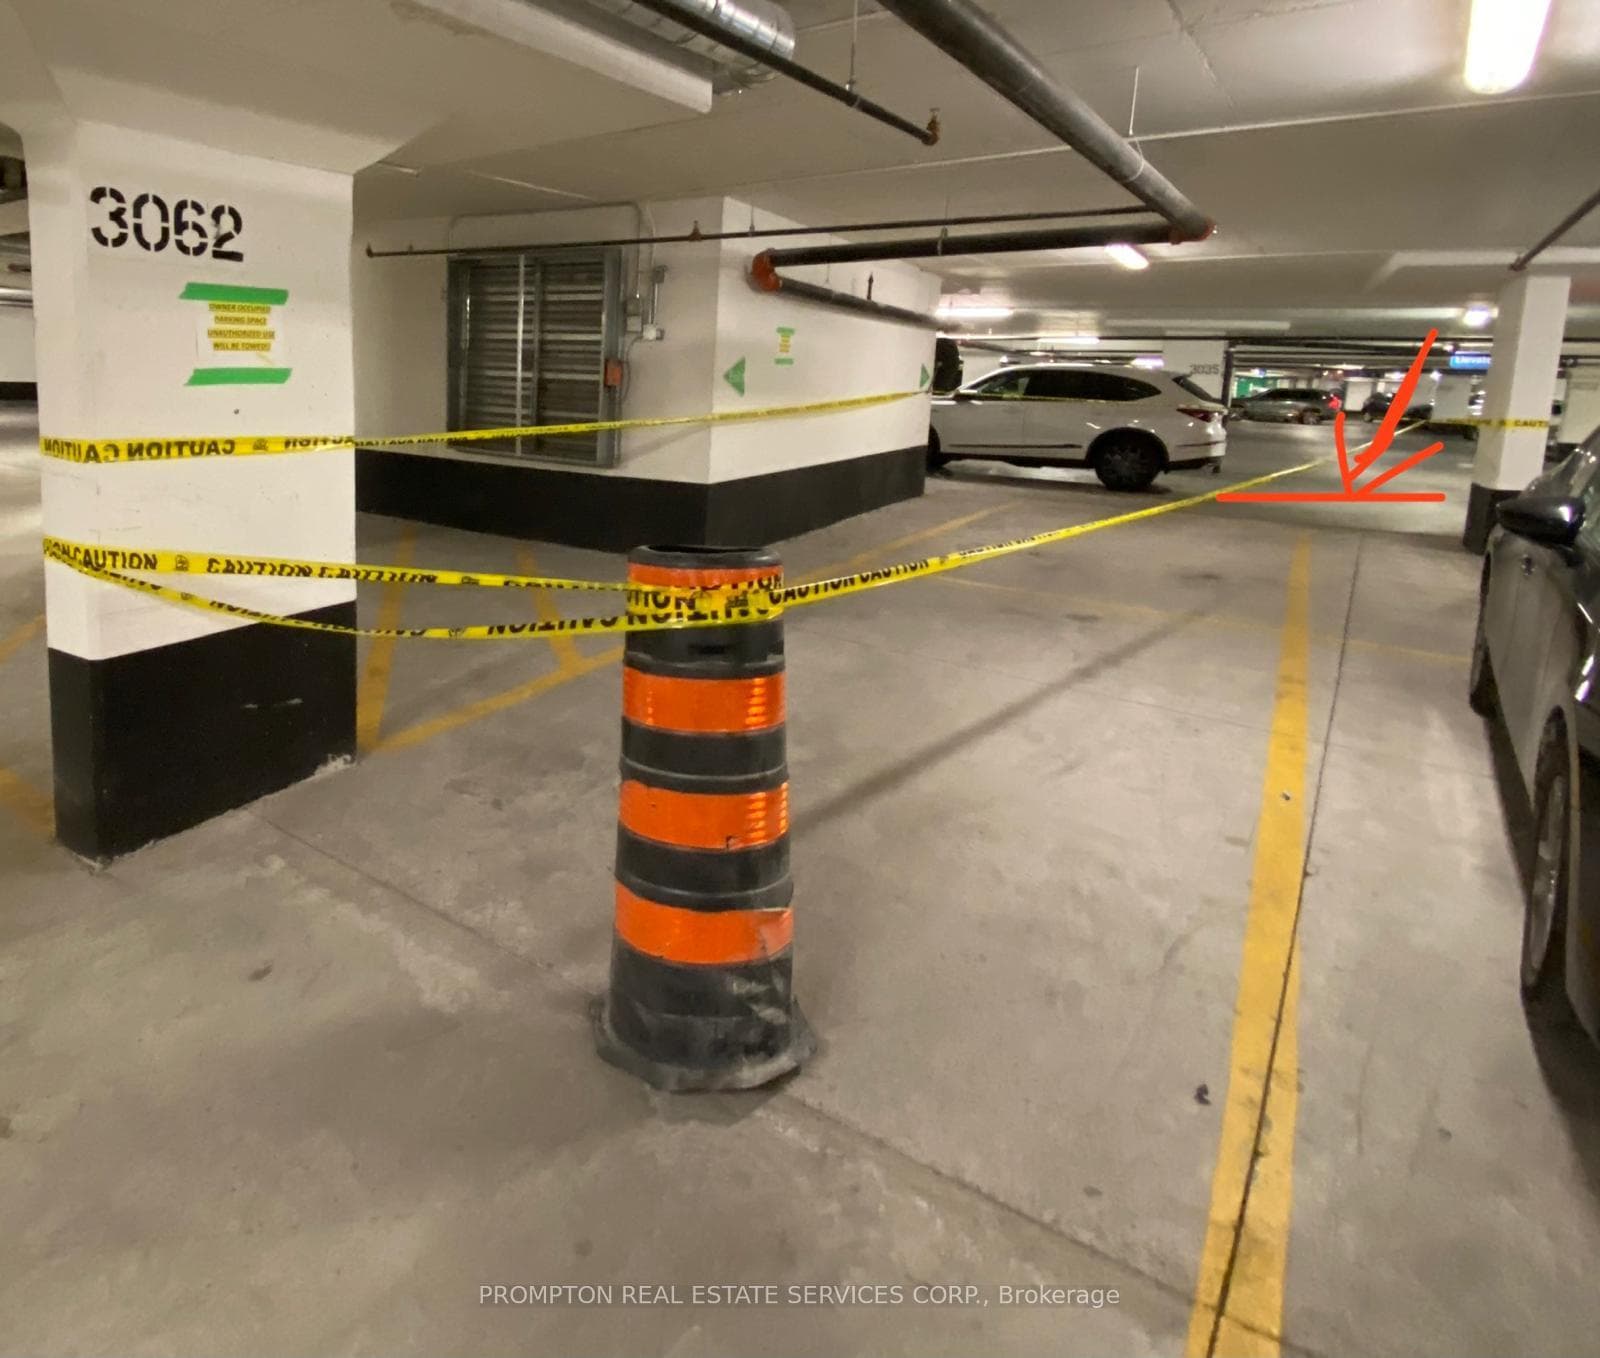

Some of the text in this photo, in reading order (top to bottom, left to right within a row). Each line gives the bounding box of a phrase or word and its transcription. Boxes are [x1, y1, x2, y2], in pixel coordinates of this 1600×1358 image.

[90, 186, 244, 262] 3062
[74, 546, 158, 572] CAUTION
[206, 557, 314, 578] CAUTION
